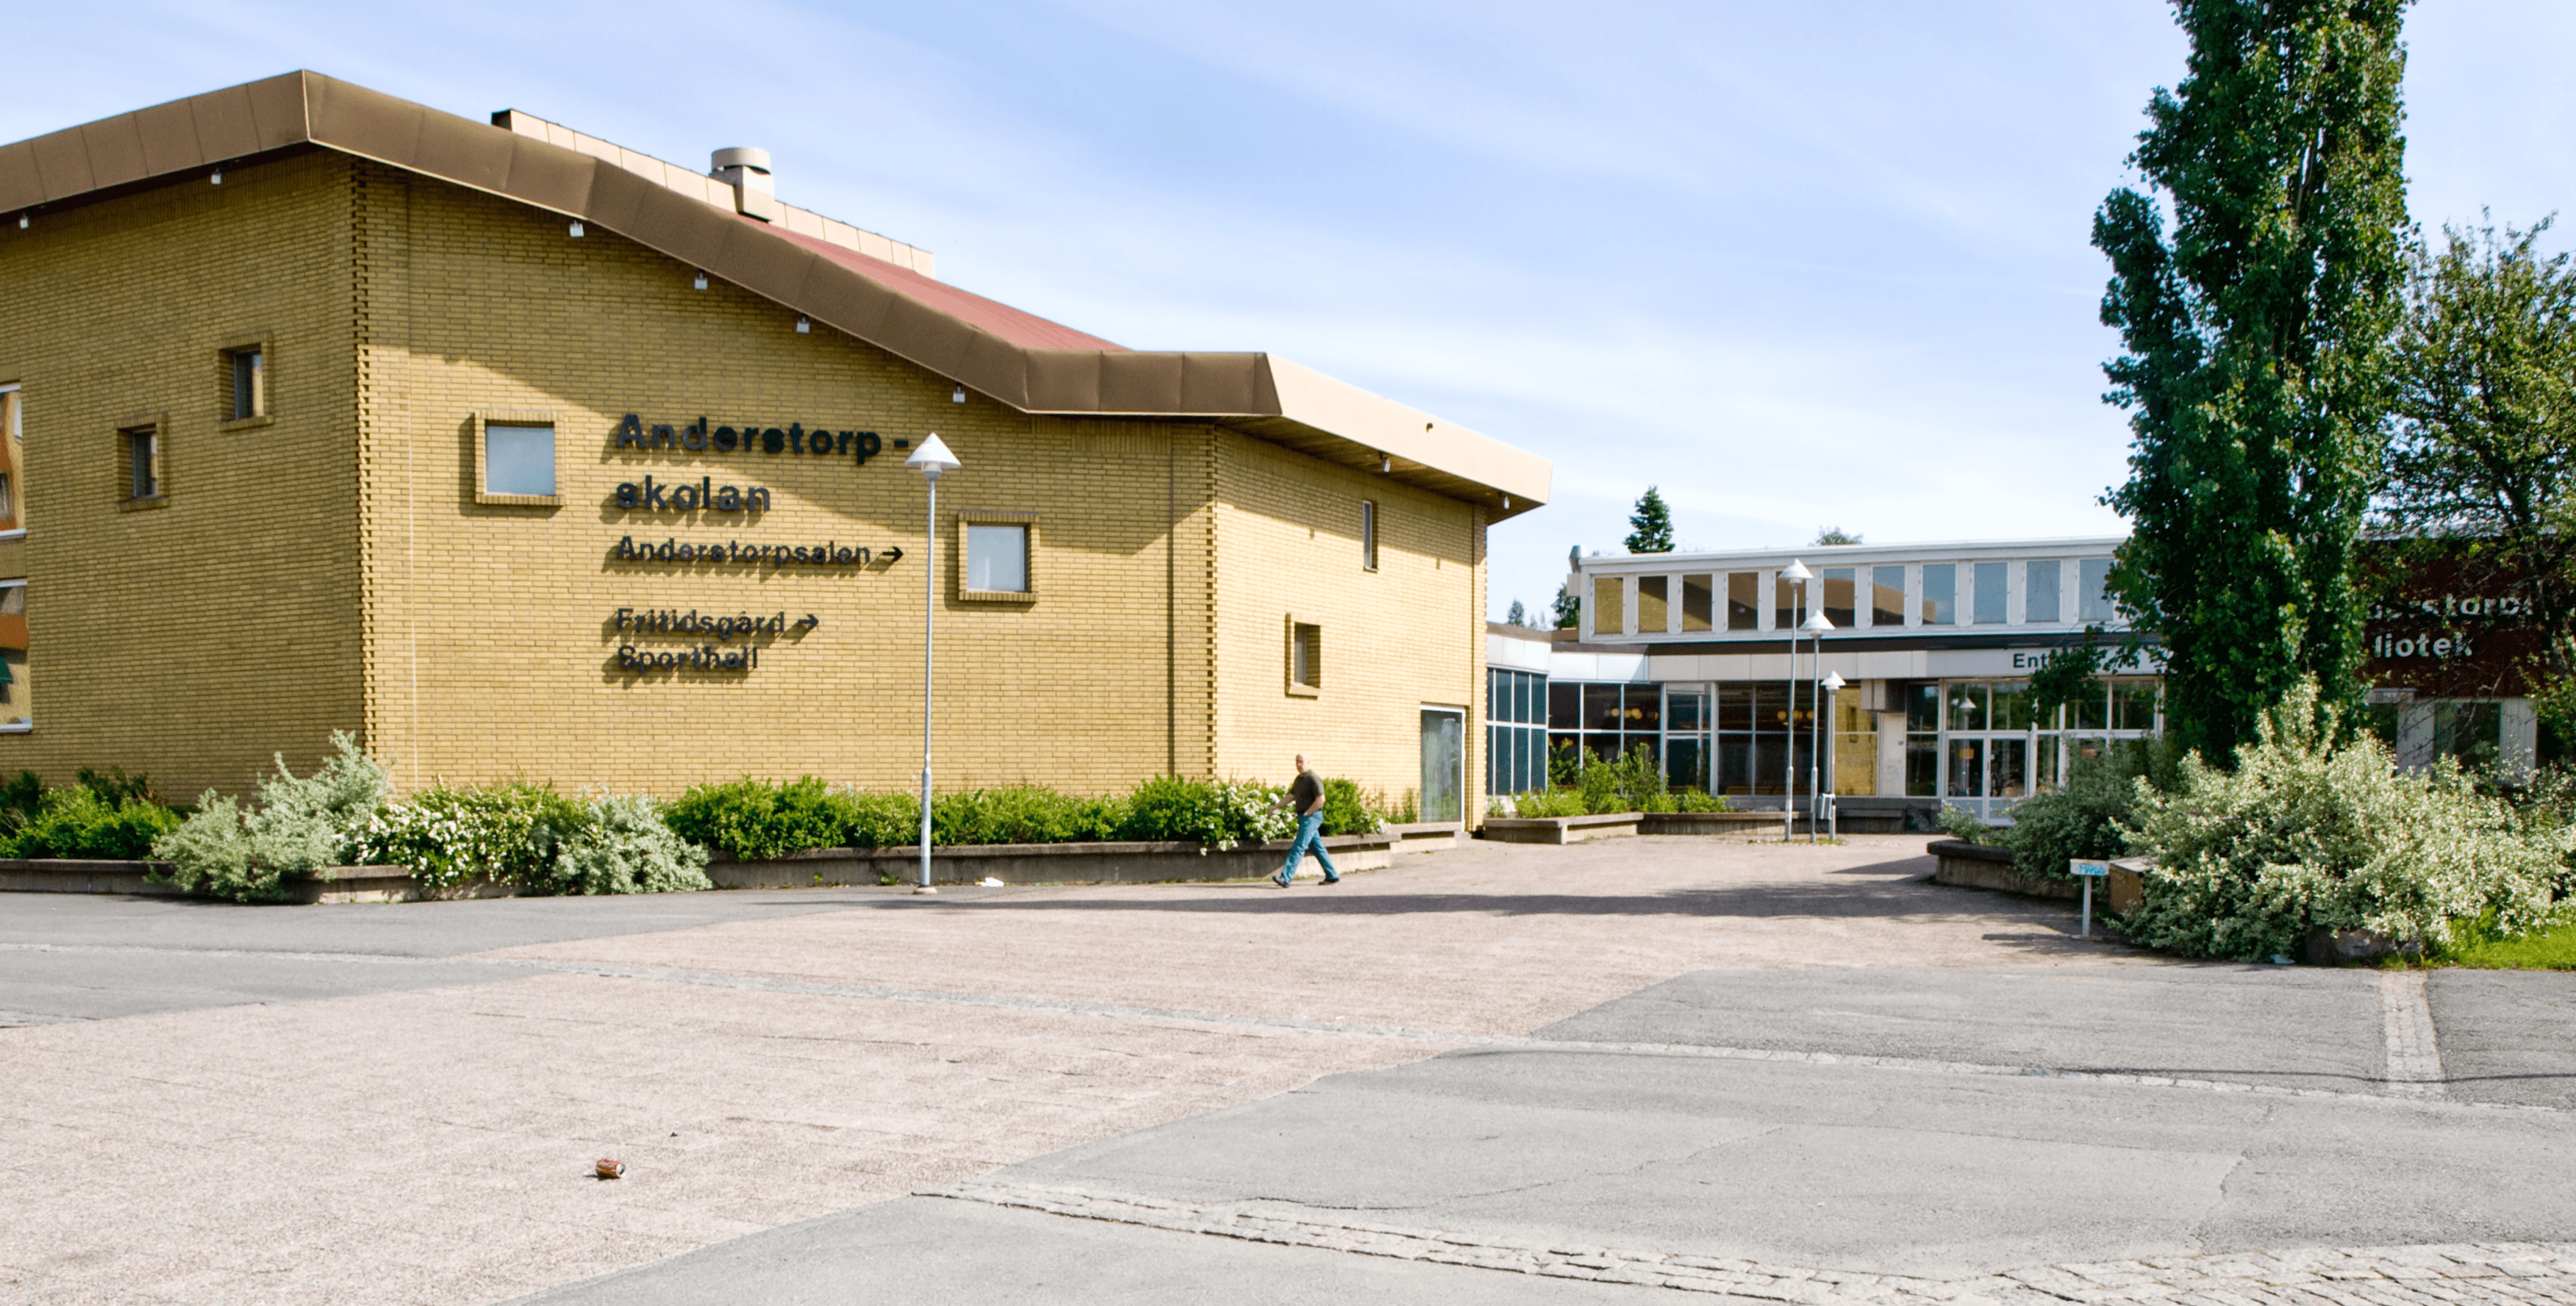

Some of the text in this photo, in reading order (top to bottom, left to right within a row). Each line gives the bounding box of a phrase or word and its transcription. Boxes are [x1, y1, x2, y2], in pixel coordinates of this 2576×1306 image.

[616, 475, 771, 512] skolan
[617, 535, 871, 569] Anderstorpsalen
[617, 608, 785, 639] Fritidsgård
[618, 645, 758, 675] Sporthall
[2373, 632, 2474, 659] liotek
[2013, 653, 2048, 669] Ent
